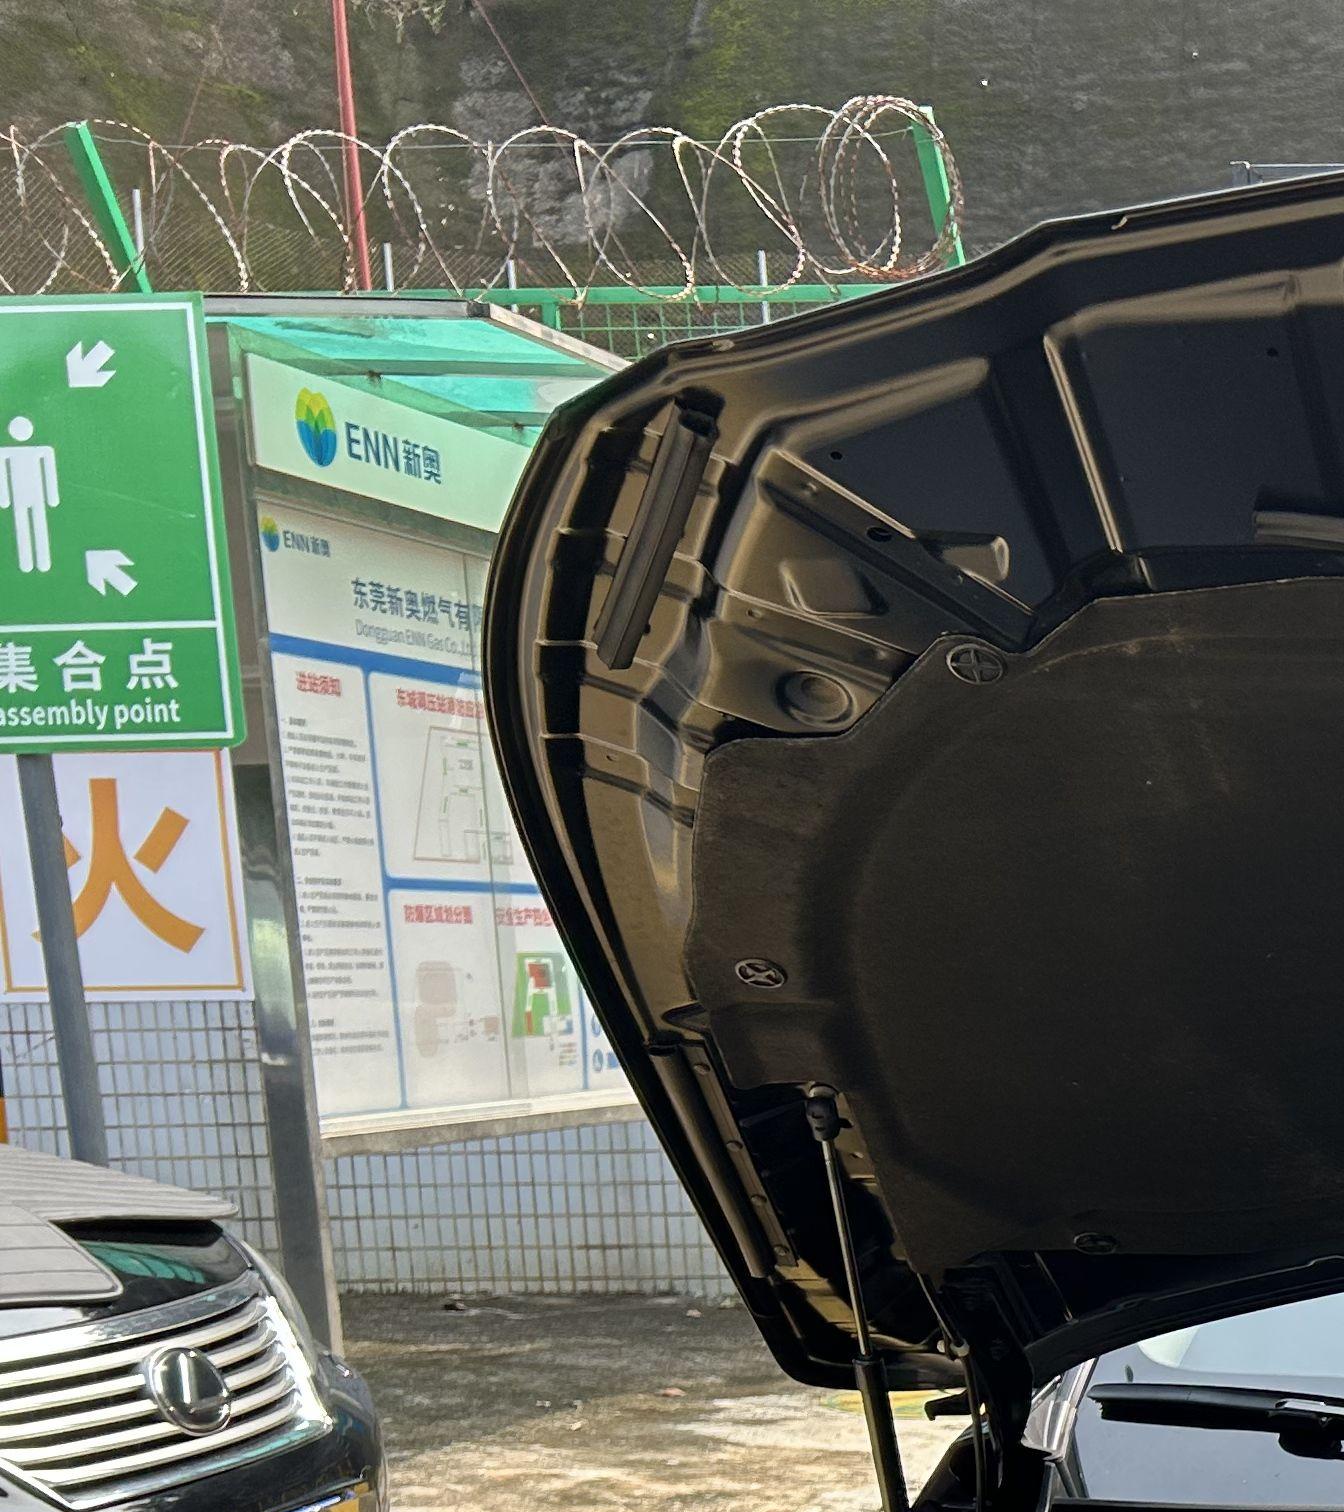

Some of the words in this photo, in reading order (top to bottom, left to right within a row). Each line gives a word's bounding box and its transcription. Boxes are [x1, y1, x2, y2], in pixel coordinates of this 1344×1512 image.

[0, 637, 180, 693] 集合点
[114, 697, 181, 730] point
[31, 777, 206, 955] 火
